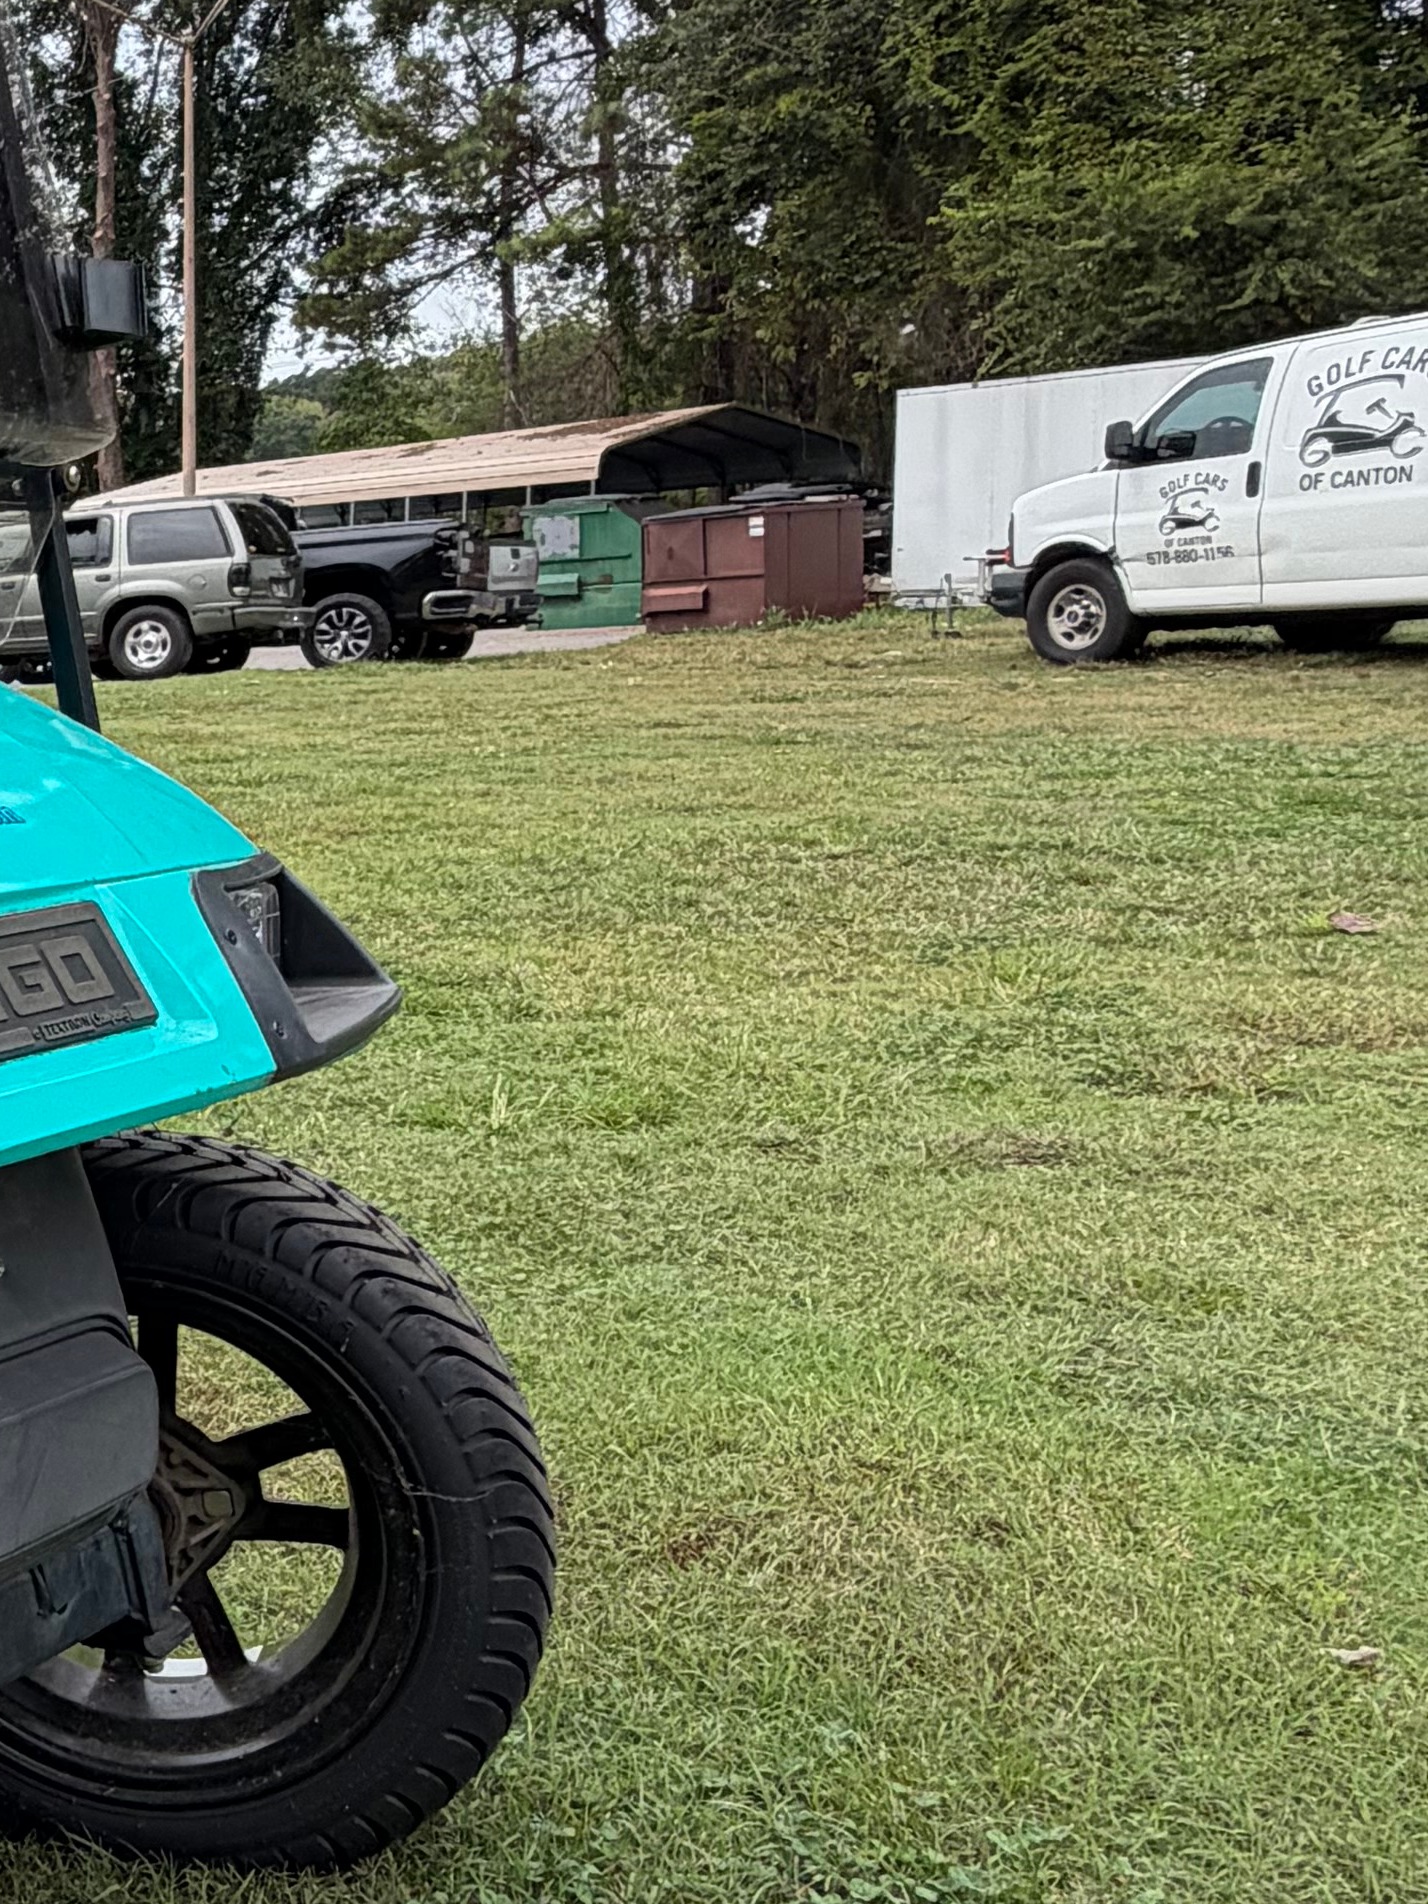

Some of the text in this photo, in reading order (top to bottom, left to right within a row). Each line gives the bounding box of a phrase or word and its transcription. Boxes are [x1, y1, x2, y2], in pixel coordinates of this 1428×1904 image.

[1307, 346, 1428, 397] GOLF CAR
[1159, 472, 1229, 498] GOLF CARS
[1299, 465, 1413, 492] OF CANTON
